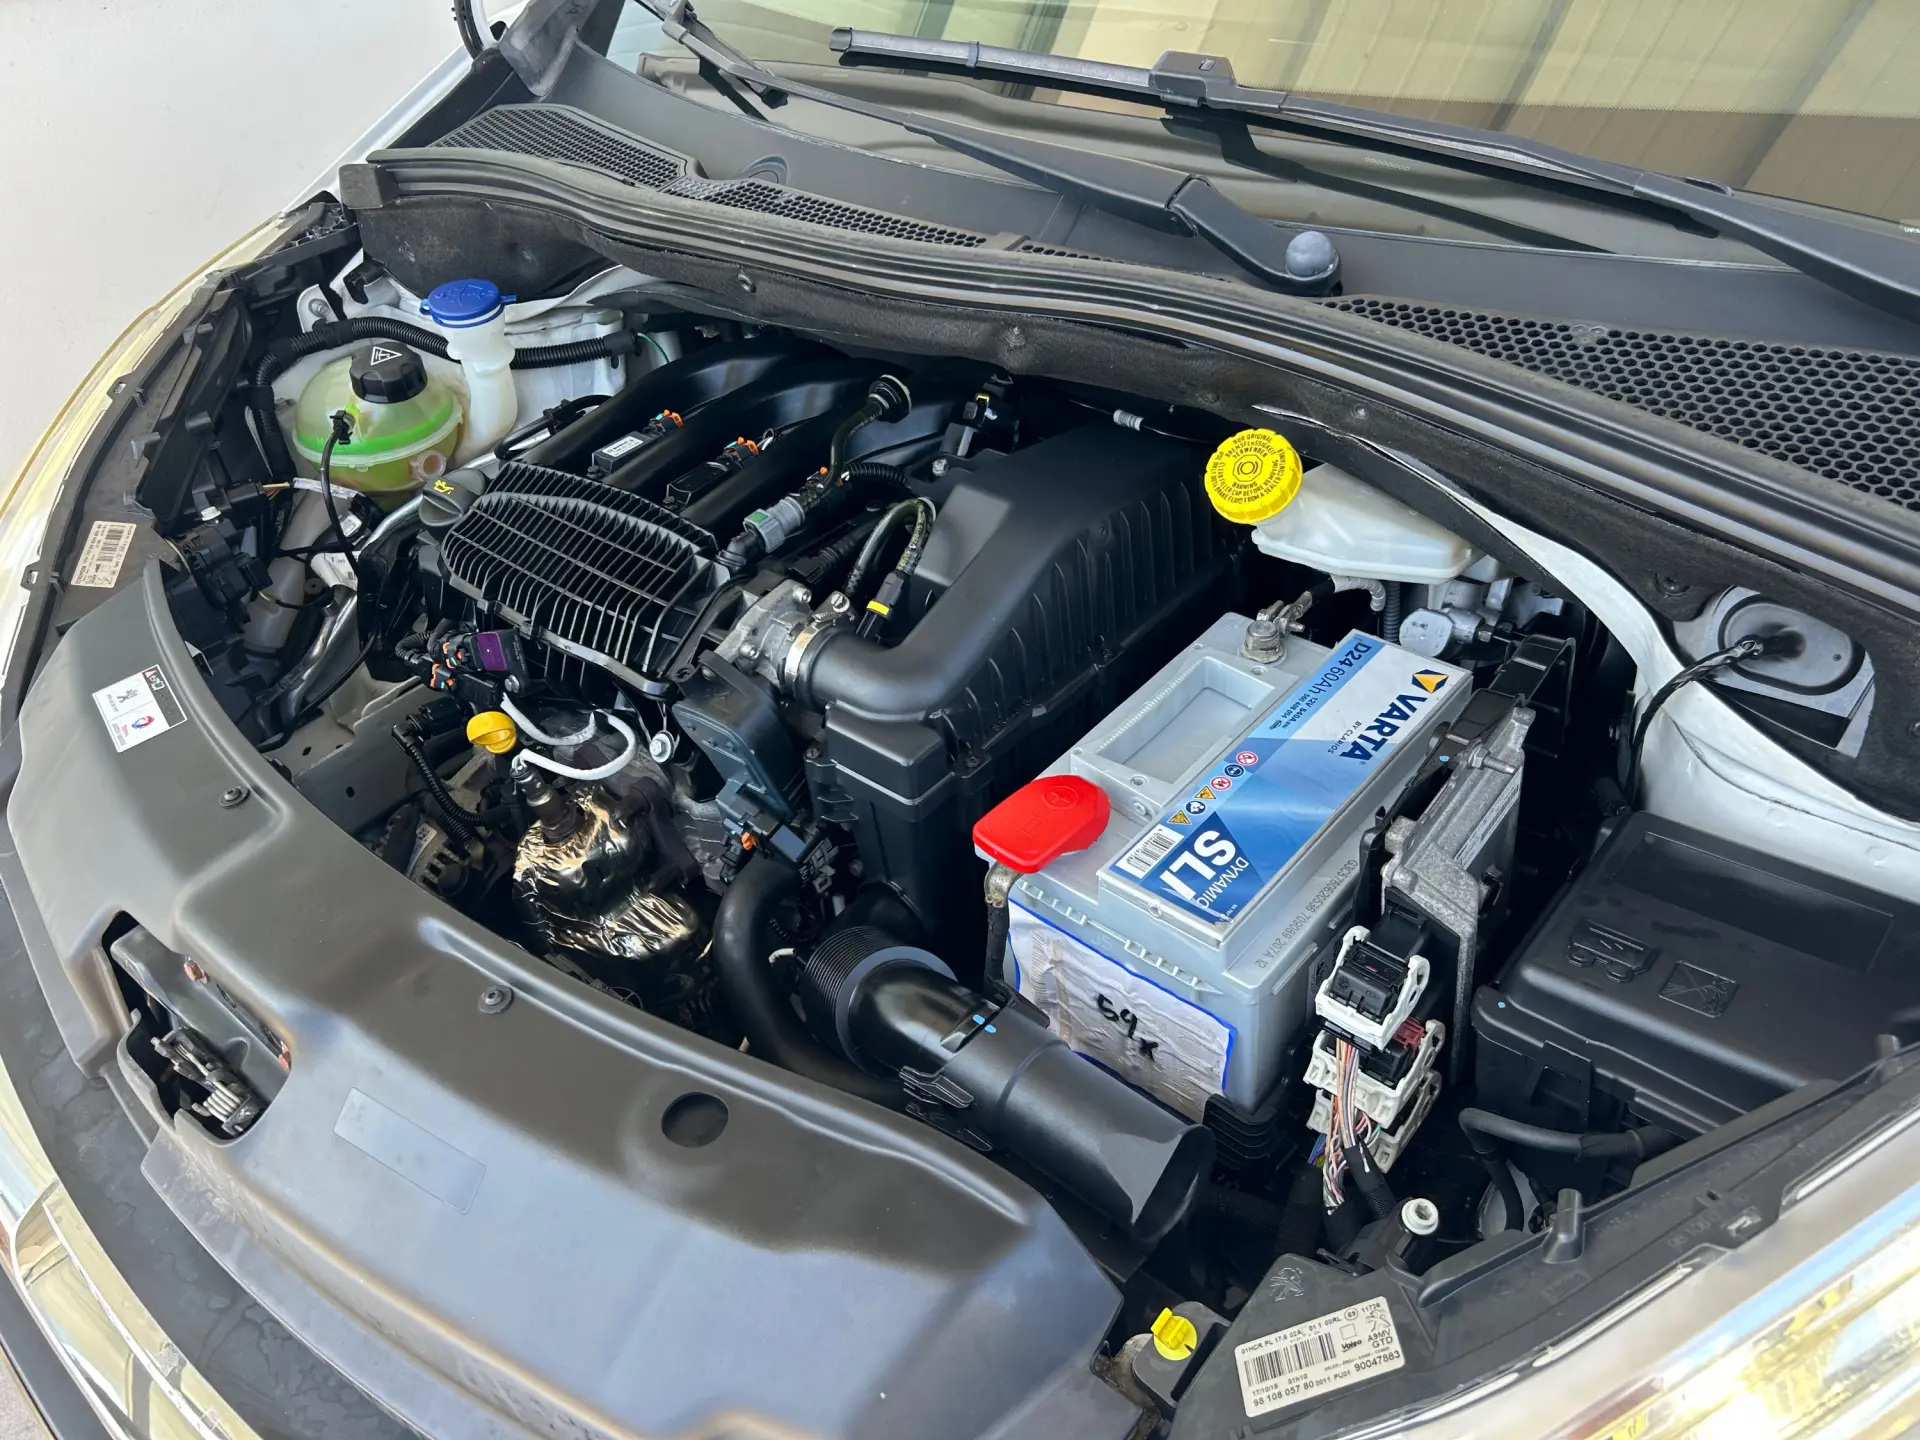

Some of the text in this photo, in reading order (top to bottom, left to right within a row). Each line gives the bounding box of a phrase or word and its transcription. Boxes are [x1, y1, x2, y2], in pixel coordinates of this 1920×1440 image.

[1247, 433, 1273, 443] ORIGINAL
[1338, 641, 1373, 668] D24
[1308, 666, 1346, 697] 60Ah
[1327, 720, 1362, 754] BY CLARIOS
[1339, 694, 1428, 761] VARTA
[1159, 829, 1236, 901] SLI
[1264, 937, 1287, 959] 207A
[1254, 958, 1268, 969] 12
[1367, 1328, 1391, 1343] A9MV
[1373, 1336, 1393, 1349] GTD
[1267, 1388, 1283, 1402] 108
[1284, 1384, 1300, 1396] 057
[1303, 1380, 1314, 1390] 80
[1354, 1350, 1401, 1372] 90047883
